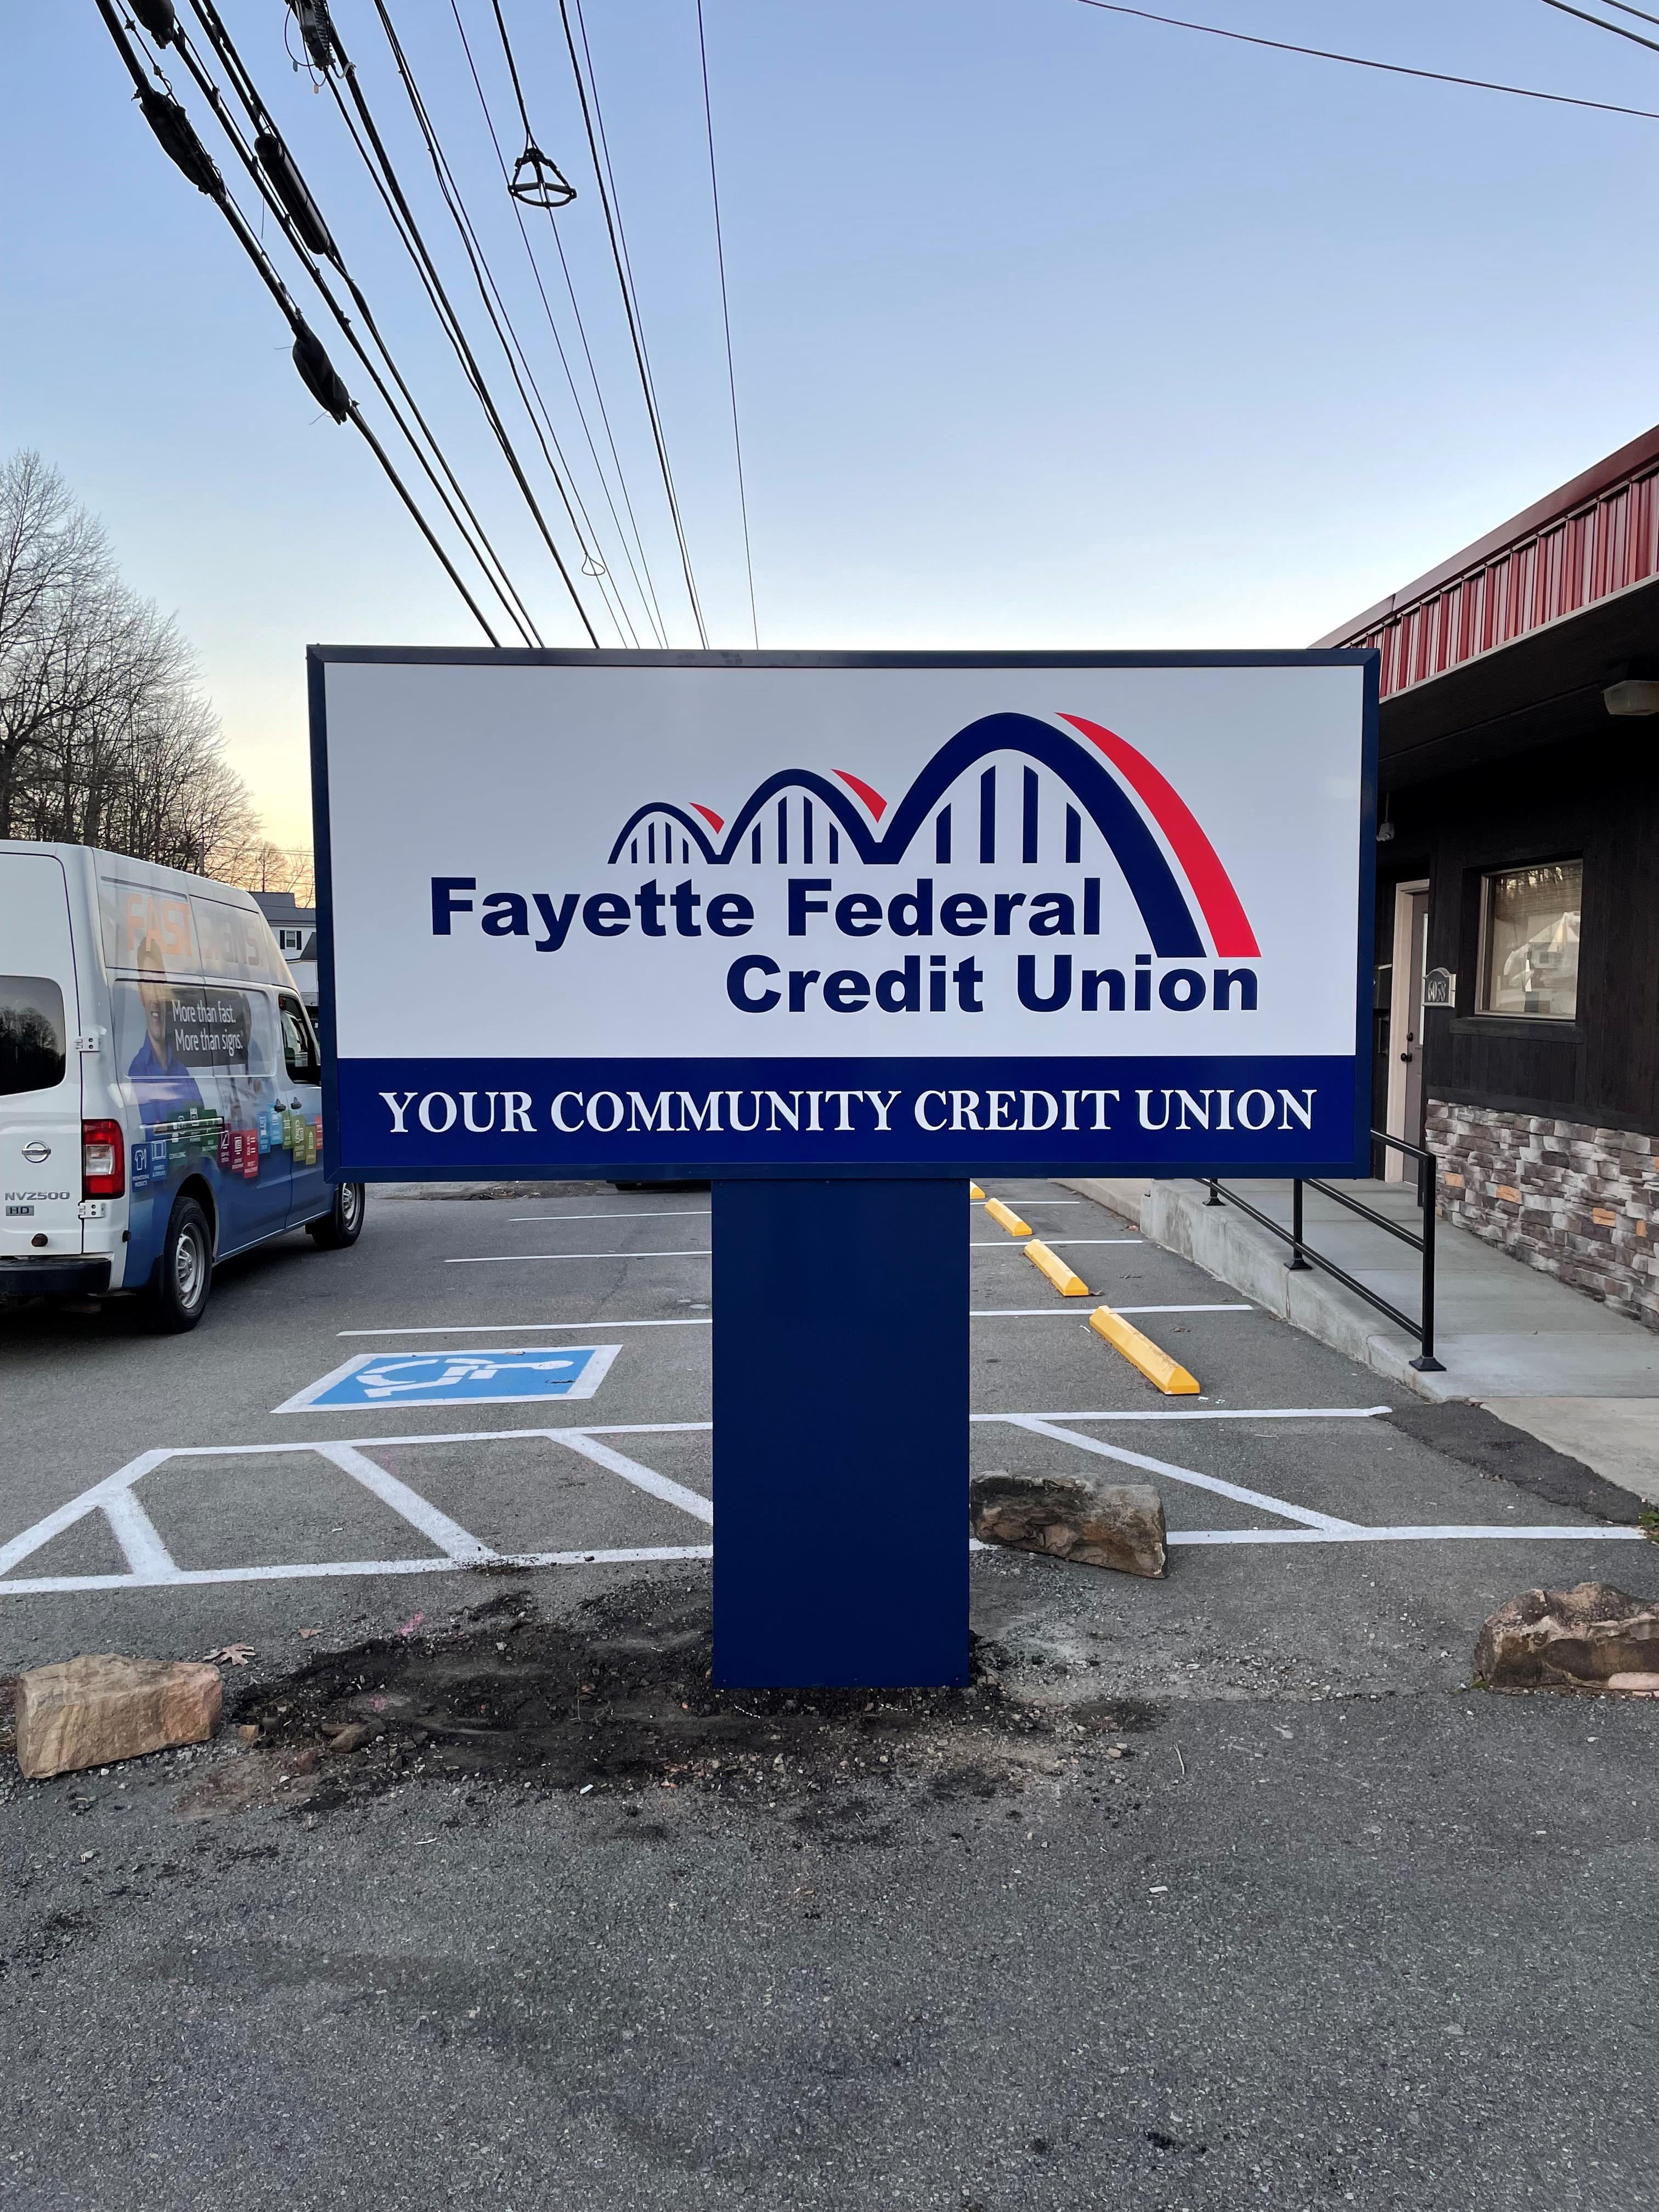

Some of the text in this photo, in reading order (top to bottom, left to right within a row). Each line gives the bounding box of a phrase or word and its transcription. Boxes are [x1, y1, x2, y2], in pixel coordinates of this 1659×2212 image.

[431, 877, 1101, 952] Fayette Federal
[726, 953, 1257, 1013] Credit Union
[172, 1000, 236, 1023] More than fast.
[174, 1029, 199, 1051] More
[200, 1028, 221, 1051] than
[379, 1088, 1317, 1133] YOUR COMMUNITY CREDIT UNION
